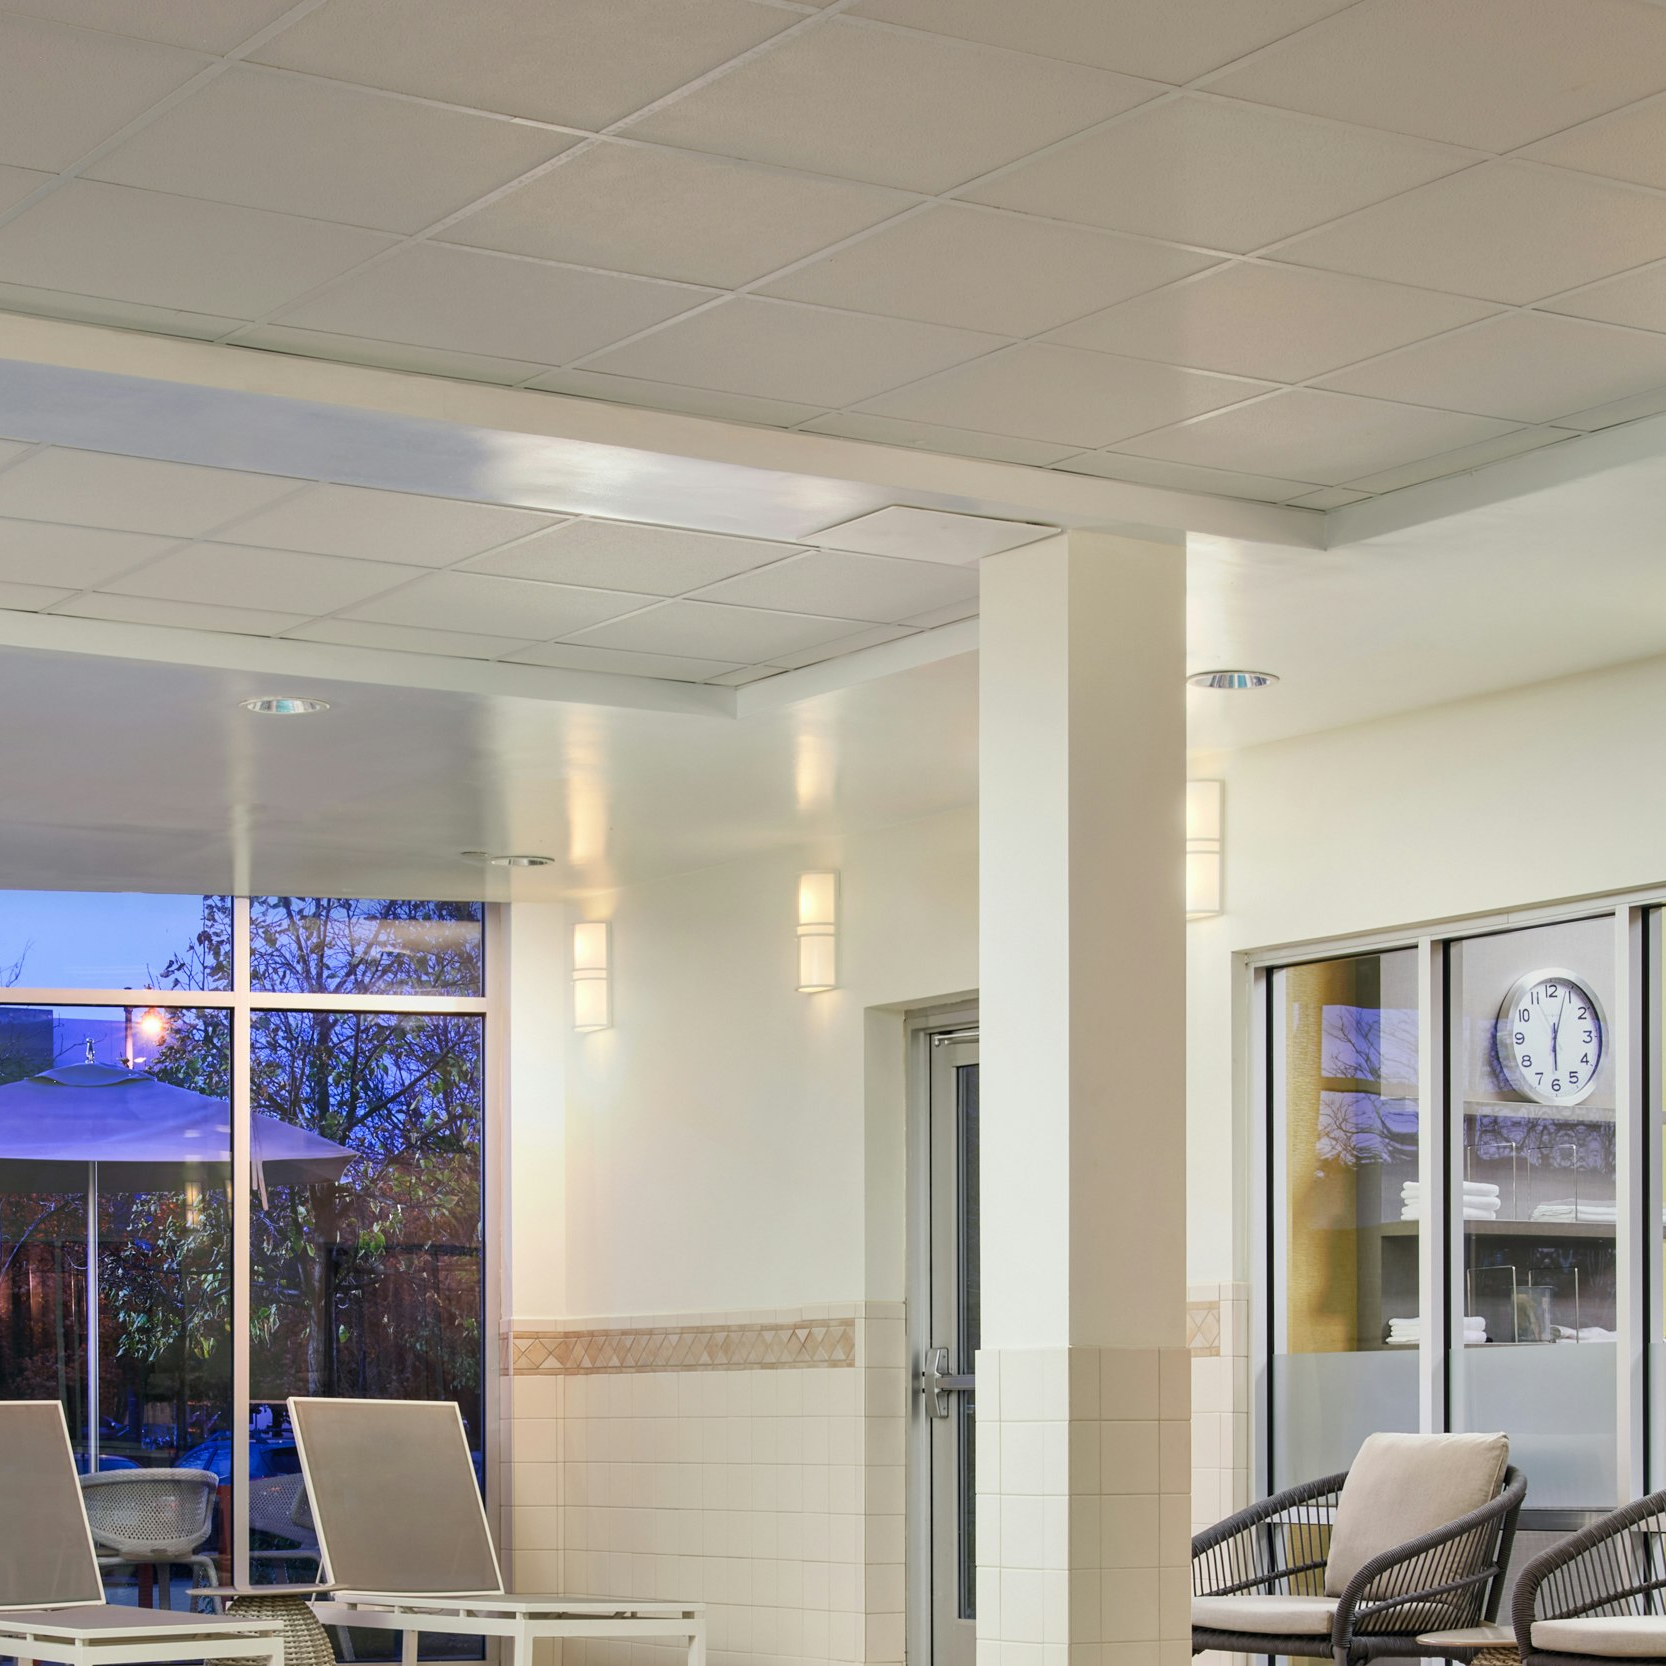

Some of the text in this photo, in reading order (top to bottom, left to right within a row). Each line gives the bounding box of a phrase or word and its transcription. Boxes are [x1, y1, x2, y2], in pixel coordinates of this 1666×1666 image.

[1530, 991, 1540, 1005] 11
[1545, 984, 1558, 998] 12
[1518, 1008, 1530, 1022] 10
[1577, 1006, 1587, 1020] 2
[1514, 1031, 1525, 1045] 9
[1582, 1030, 1592, 1044] 3
[1521, 1054, 1532, 1067] 8
[1580, 1052, 1590, 1065] 4
[1534, 1072, 1544, 1085] 7
[1568, 1071, 1579, 1084] 5
[1551, 1078, 1561, 1092] 6
